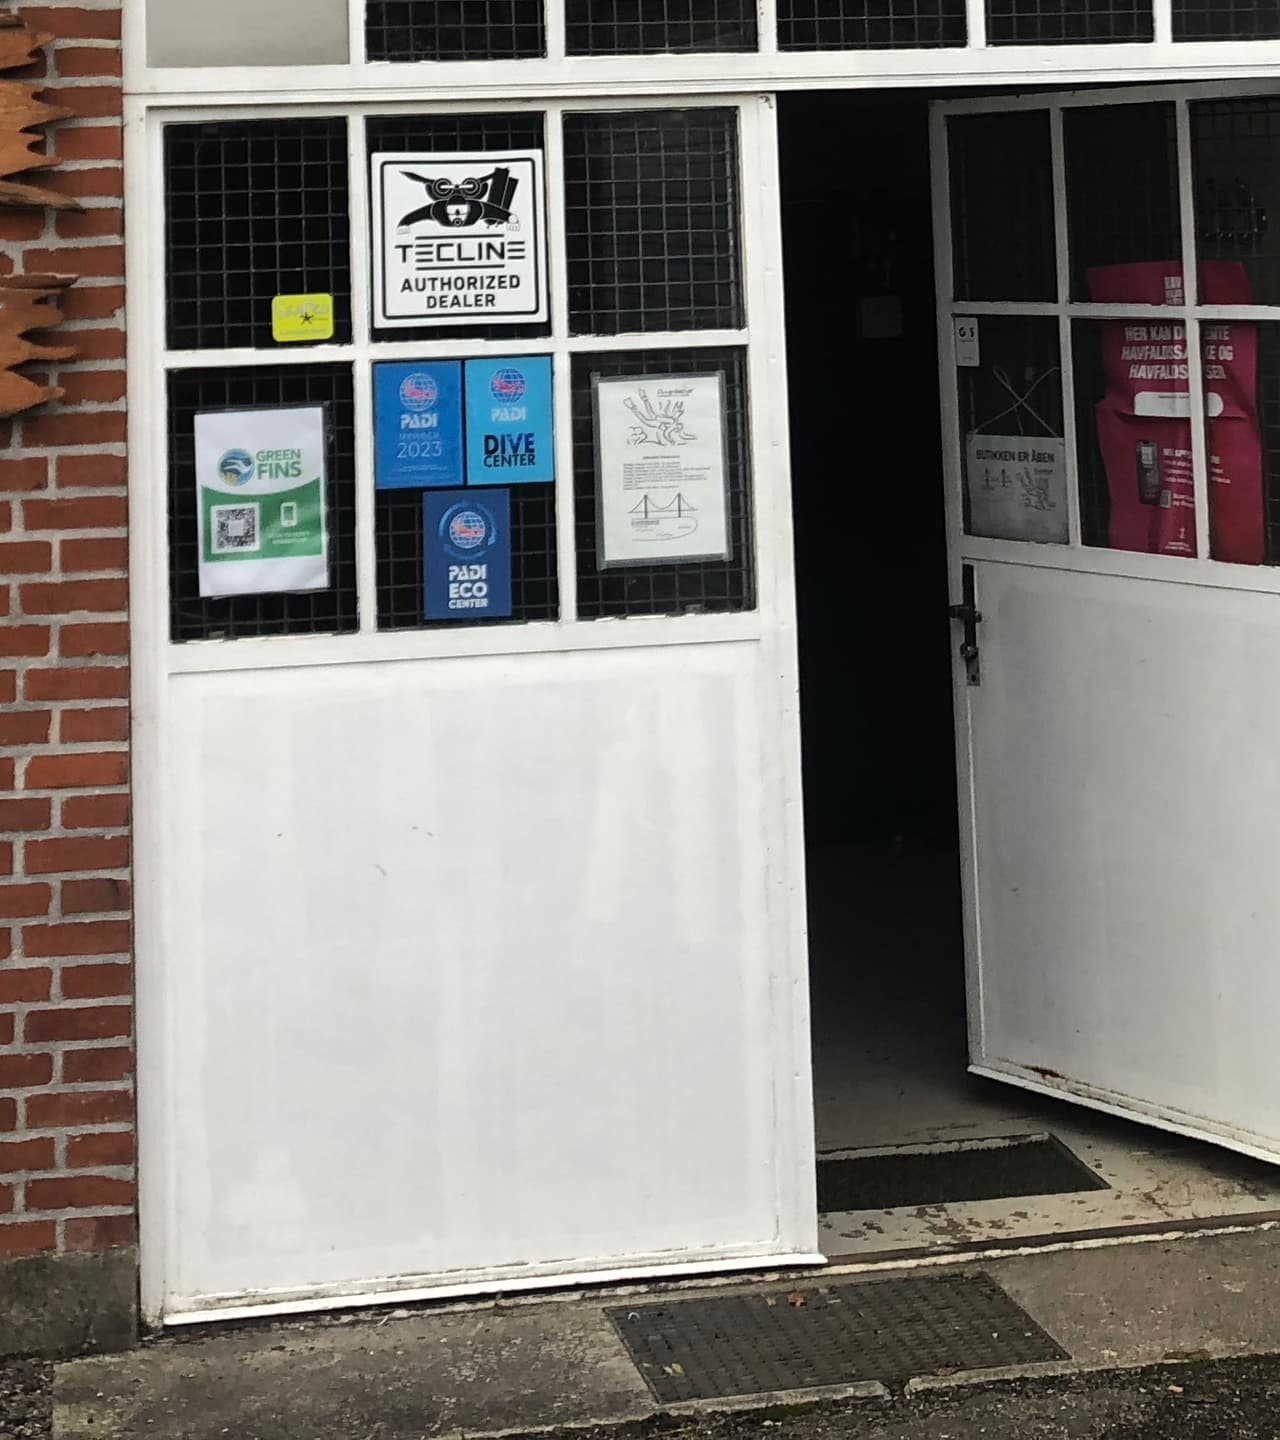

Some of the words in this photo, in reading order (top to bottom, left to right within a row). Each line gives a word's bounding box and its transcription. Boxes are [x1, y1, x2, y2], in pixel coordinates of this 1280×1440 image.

[393, 240, 526, 264] TECLINE
[400, 274, 521, 294] AUTHORIZED
[426, 293, 496, 310] DEALER
[400, 412, 439, 429] PADI
[491, 406, 527, 422] PADI
[397, 440, 442, 459] 2023
[483, 432, 536, 456] DIVE
[255, 448, 301, 462] GREEN
[483, 453, 536, 468] CENTER
[256, 461, 302, 480] FINS
[448, 564, 488, 581] PADI
[448, 582, 488, 598] ECO
[448, 598, 489, 609] CENTER
